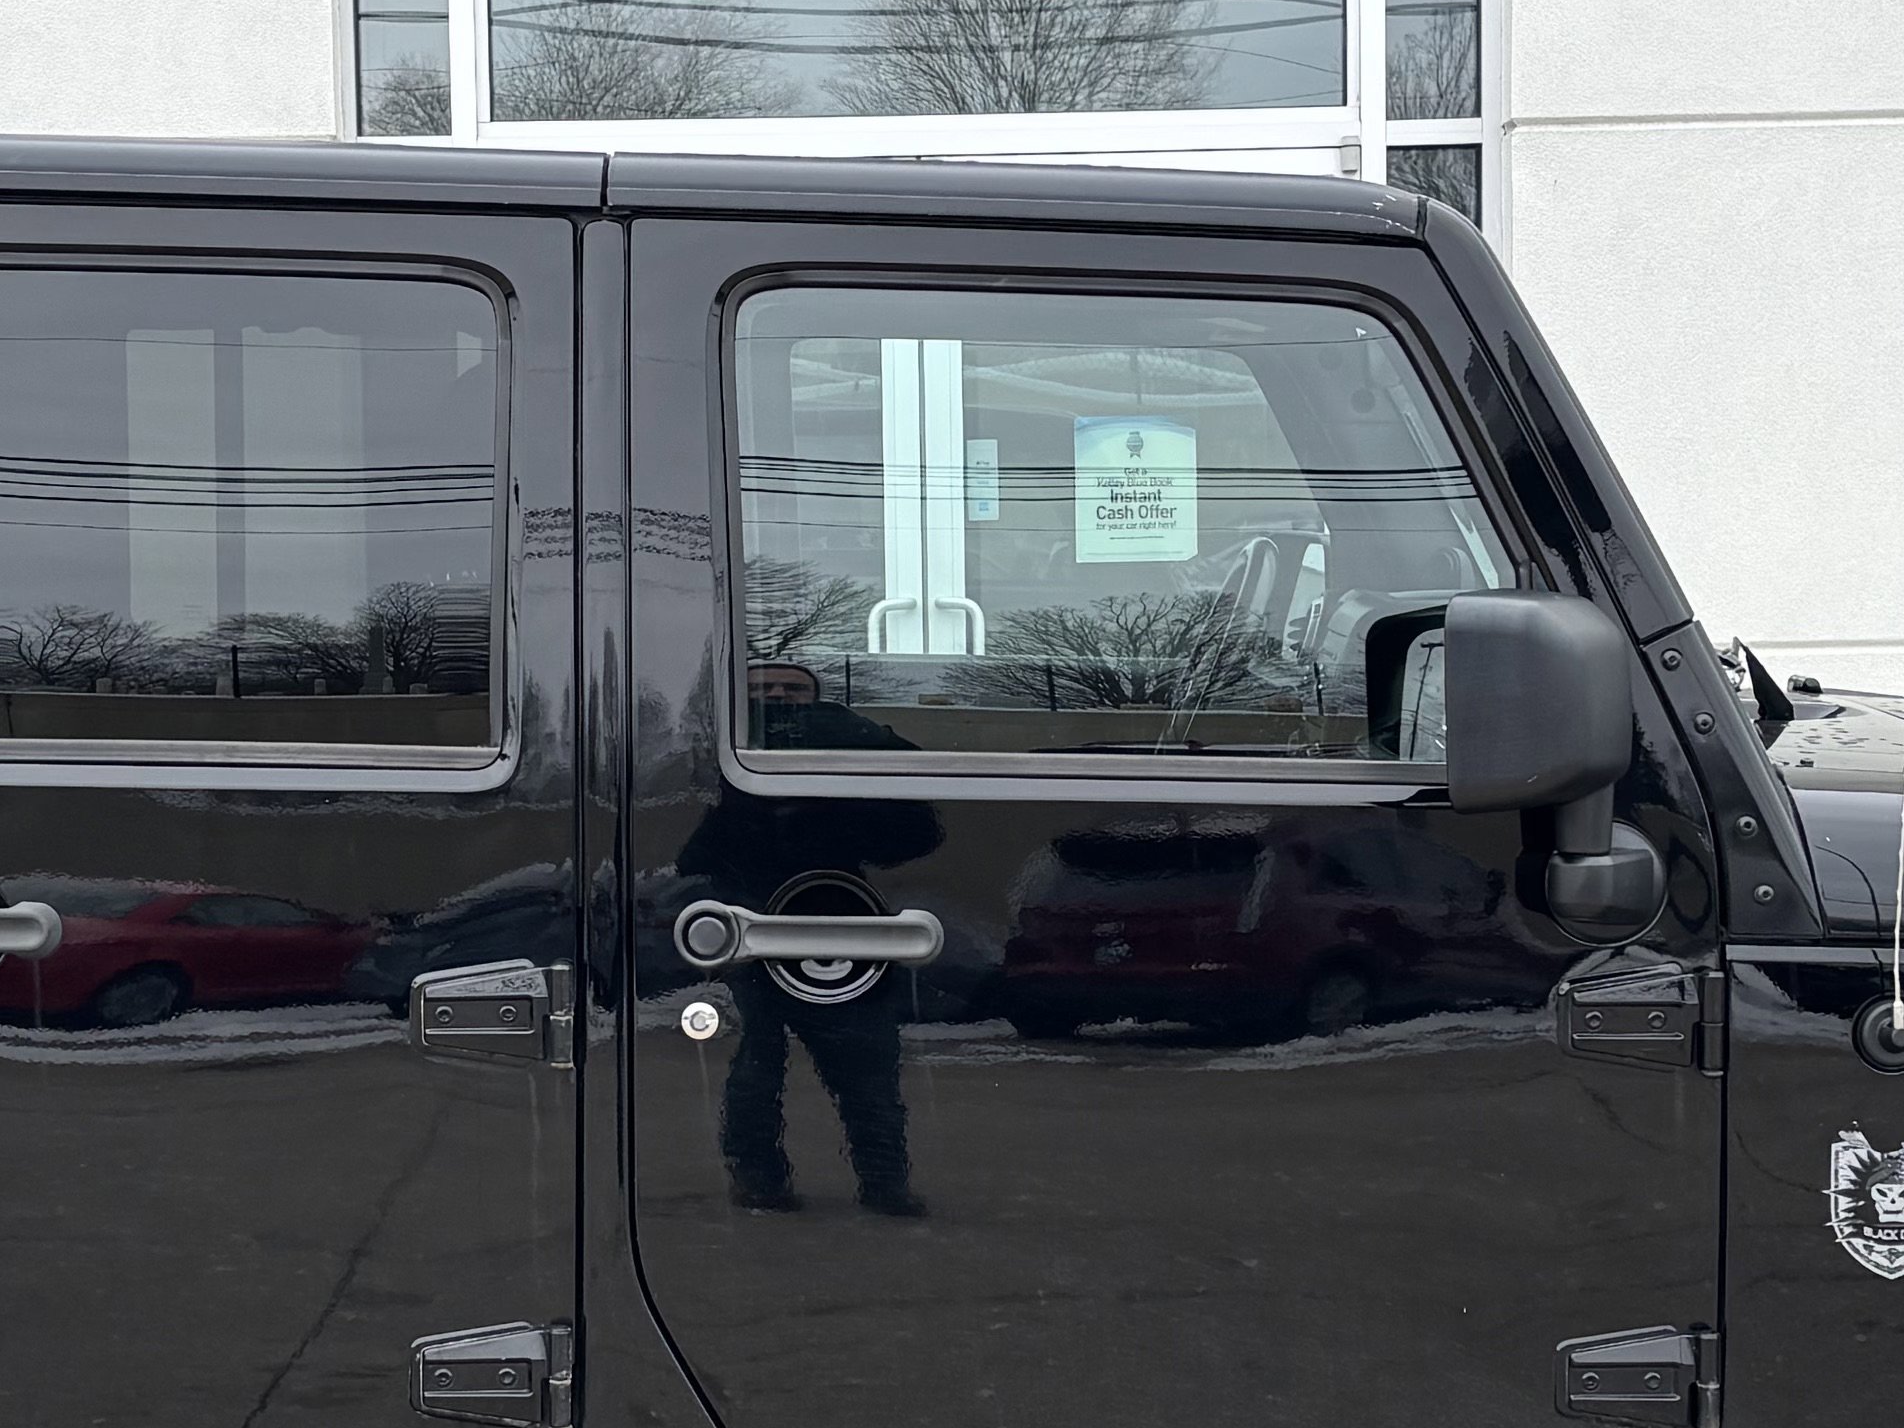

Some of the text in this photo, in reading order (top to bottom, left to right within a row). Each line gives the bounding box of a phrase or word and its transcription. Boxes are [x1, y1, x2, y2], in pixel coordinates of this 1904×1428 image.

[1123, 467, 1139, 476] Get
[1110, 488, 1162, 503] Instant
[1096, 504, 1177, 520] Cash Offer
[1139, 521, 1156, 530] right
[1863, 1225, 1899, 1241] BLACK
